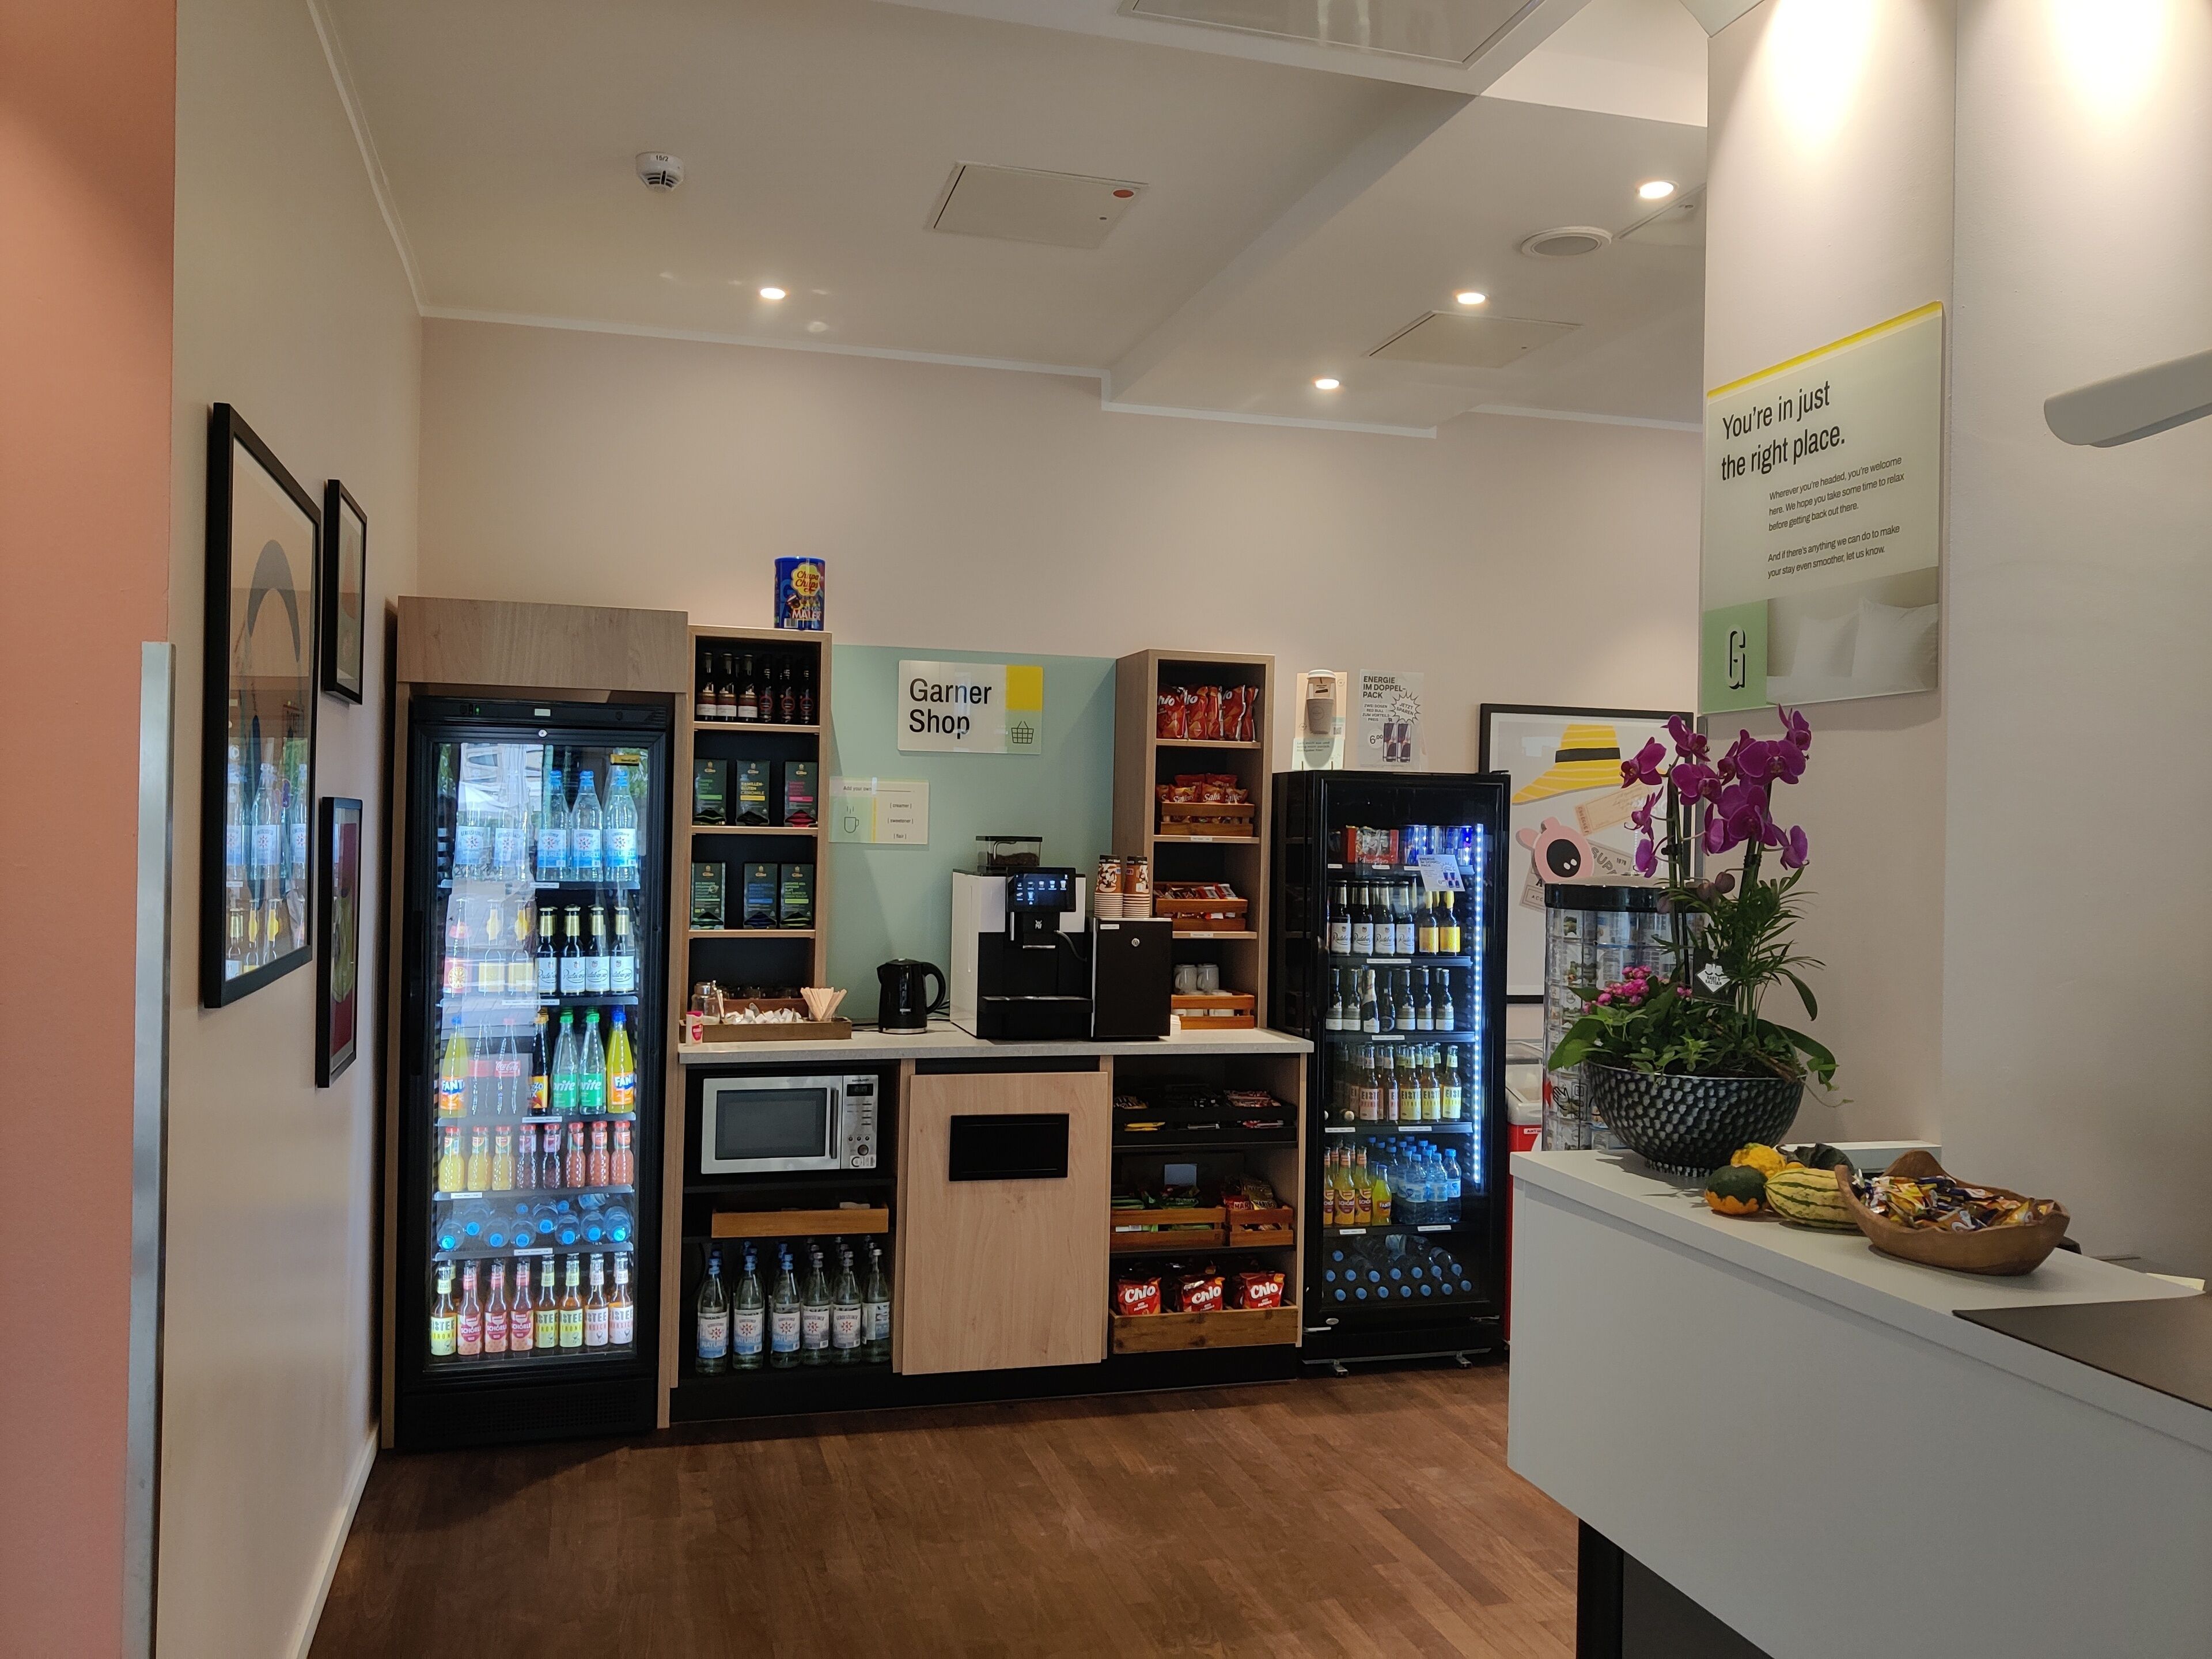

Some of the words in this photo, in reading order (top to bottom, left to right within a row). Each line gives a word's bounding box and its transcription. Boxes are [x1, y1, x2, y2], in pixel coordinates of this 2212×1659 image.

[1722, 406, 1772, 440] You're
[1778, 396, 1793, 422] in
[1797, 380, 1830, 422] just
[1721, 454, 1745, 480] the
[1751, 437, 1788, 475] right
[1793, 425, 1845, 465] place.
[1769, 486, 1798, 501] Wherever
[1800, 480, 1819, 494] you're
[1820, 472, 1847, 486] headed,
[1848, 465, 1869, 480] you're
[1870, 456, 1902, 472] welcome
[1769, 505, 1784, 516] here.
[1785, 502, 1796, 512] We
[1797, 497, 1813, 509] hope
[1814, 494, 1826, 506] you
[1827, 490, 1841, 501] take
[1842, 485, 1861, 497] some
[1862, 479, 1877, 491] time
[1878, 478, 1885, 486] to
[1887, 472, 1905, 484] relax
[1768, 519, 1788, 531] before
[1789, 514, 1810, 528] getting
[1812, 509, 1827, 521] back
[1828, 507, 1839, 516] out
[1840, 501, 1859, 514] there.
[1768, 551, 1781, 562] And
[1782, 550, 1786, 559] if
[1786, 546, 1807, 559] there's
[1808, 539, 1836, 554] anything
[1837, 537, 1847, 546] we
[1847, 534, 1861, 544] can
[1861, 531, 1871, 541] do
[1872, 529, 1879, 539] to
[1880, 524, 1900, 537] make
[1767, 568, 1782, 579] your
[1782, 565, 1795, 575] stay
[1796, 561, 1812, 571] even
[1813, 553, 1844, 568] smoother,
[1846, 551, 1855, 560] let
[1855, 550, 1864, 558] us
[1865, 546, 1885, 556] know.
[909, 678, 993, 704] Garner
[1363, 676, 1395, 684] ENERGIE
[1374, 684, 1406, 692] DOPPEL-
[909, 709, 970, 740] Shop
[1396, 706, 1414, 715] SPAREN
[1124, 1285, 1156, 1303] Chio
[1191, 1286, 1221, 1304] Chio
[1251, 1282, 1278, 1298] Chio
